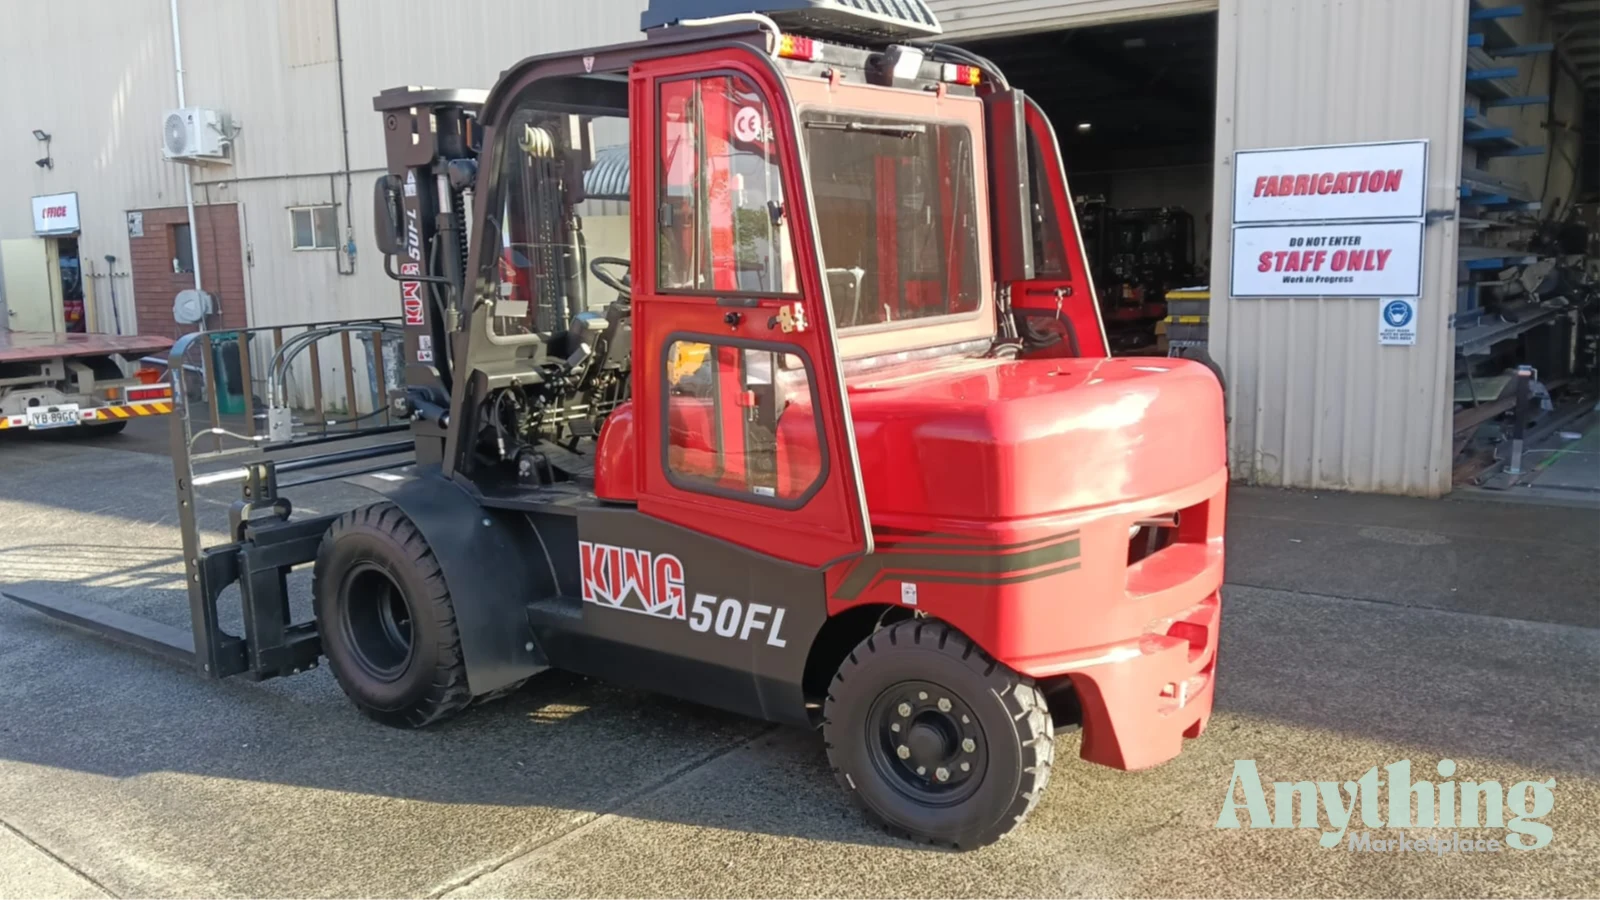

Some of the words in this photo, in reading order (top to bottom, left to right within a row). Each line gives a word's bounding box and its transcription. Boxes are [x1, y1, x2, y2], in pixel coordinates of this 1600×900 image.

[737, 115, 756, 133] CE
[1253, 169, 1403, 198] FABRICATION
[1289, 237, 1304, 247] DO
[1305, 237, 1327, 247] NOT
[1328, 236, 1362, 246] ENTER
[1257, 250, 1328, 273] STAFF
[1330, 249, 1393, 272] ONLY
[1315, 275, 1354, 284] Progress
[579, 541, 687, 621] KING
[689, 593, 787, 648] 50FL
